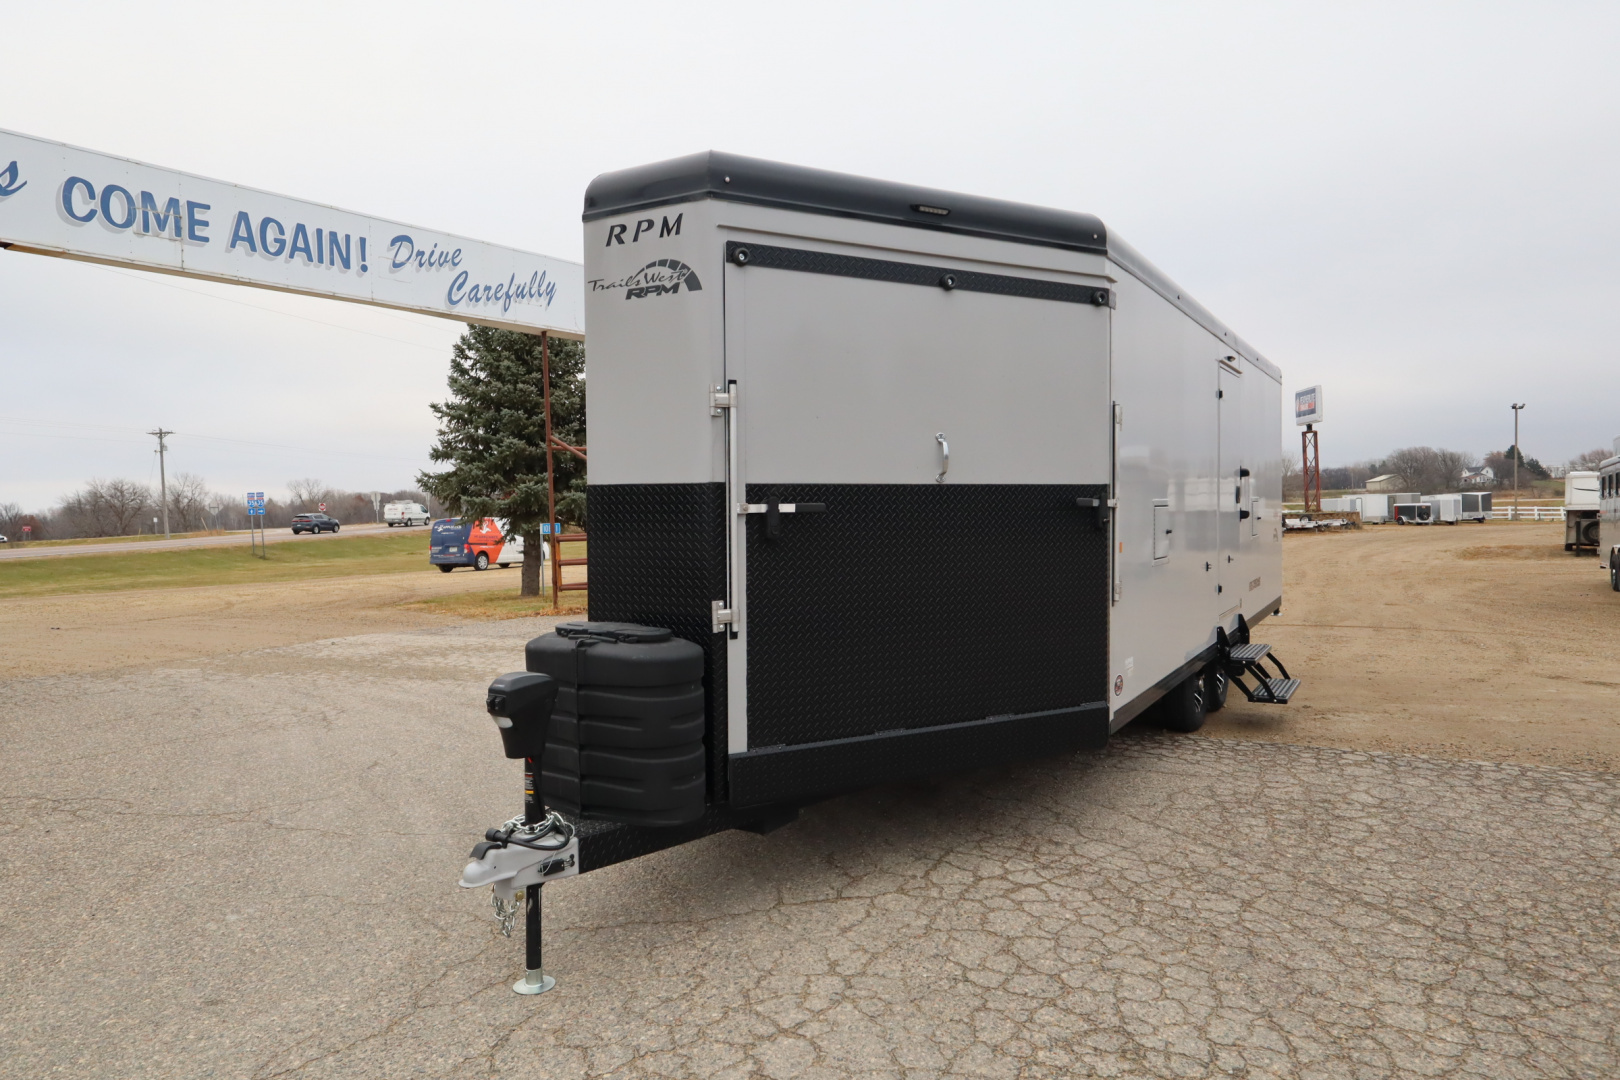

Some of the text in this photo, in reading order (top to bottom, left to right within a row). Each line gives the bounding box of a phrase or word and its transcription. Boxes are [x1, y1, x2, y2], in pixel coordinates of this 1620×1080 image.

[63, 176, 211, 243] COME
[230, 211, 369, 273] AGAIN!
[605, 212, 683, 247] RPM
[390, 234, 463, 270] Drive
[447, 270, 557, 314] Carefully
[587, 269, 683, 292] Trails West
[625, 281, 680, 301] RPM
